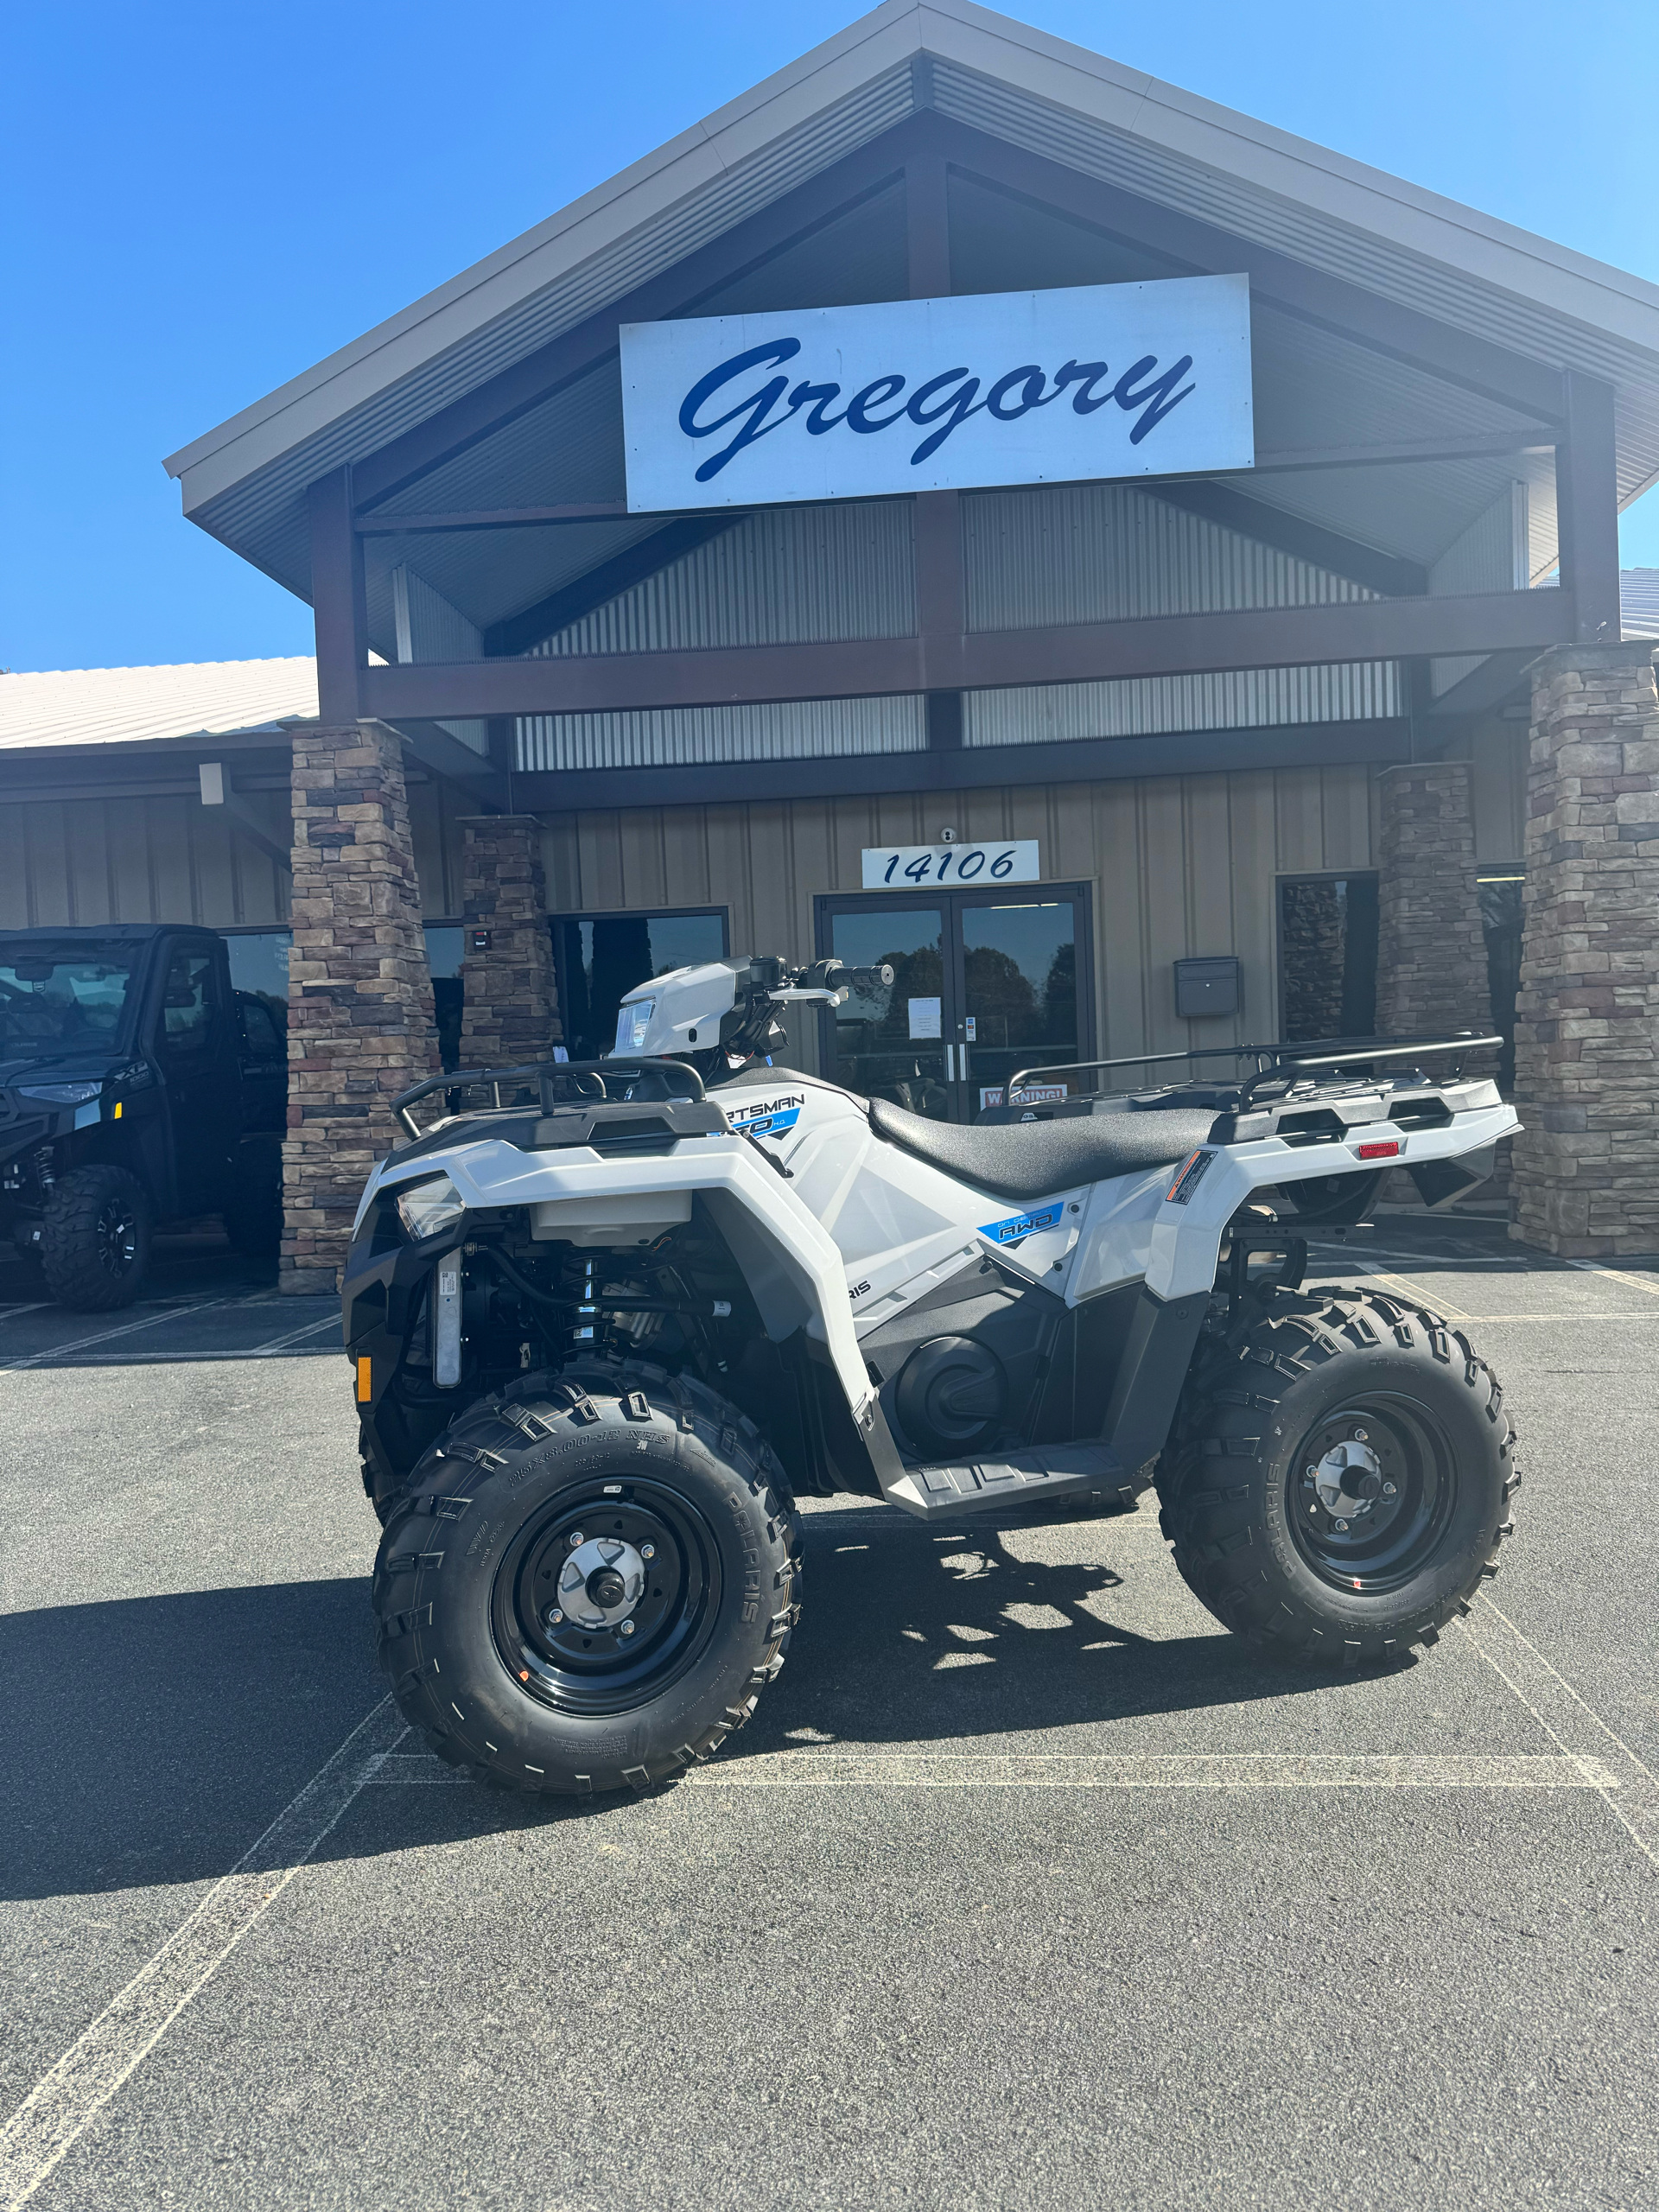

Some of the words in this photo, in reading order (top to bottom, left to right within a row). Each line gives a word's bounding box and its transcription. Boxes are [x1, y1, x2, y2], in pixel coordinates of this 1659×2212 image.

[678, 337, 1196, 482] Gregory
[884, 850, 1017, 884] 14106
[122, 1061, 145, 1079] XP
[130, 1071, 149, 1083] 1000
[726, 1094, 804, 1123] RTSMAN
[988, 1090, 1060, 1104] WRNING!
[999, 1214, 1052, 1240] AWD
[849, 1280, 871, 1300] RIS
[722, 1491, 761, 1624] POLARIS
